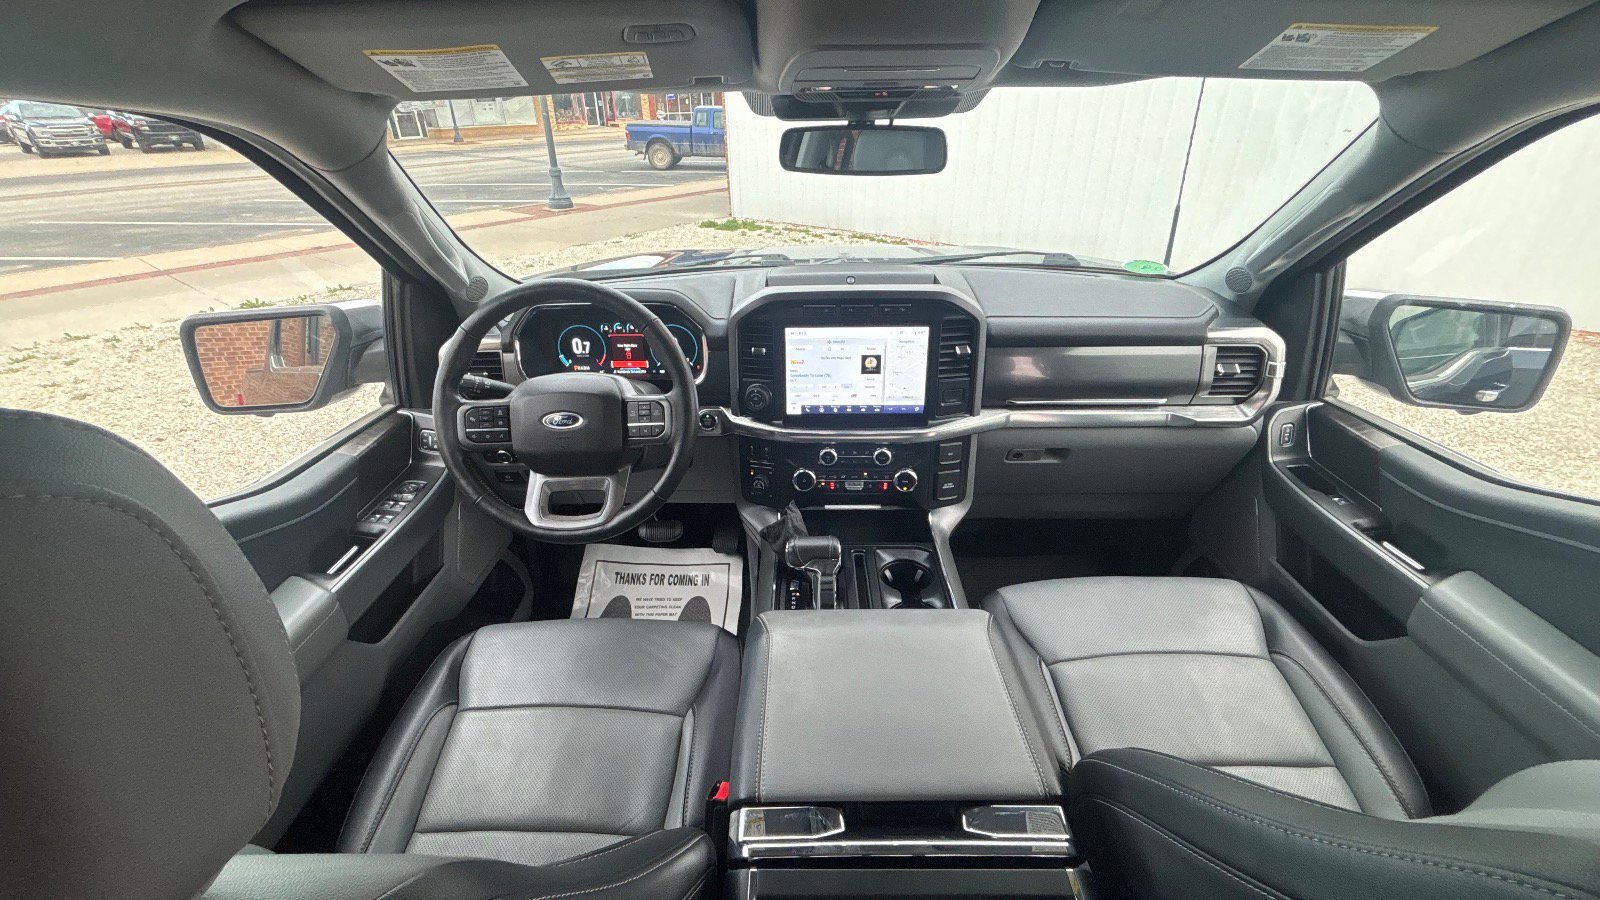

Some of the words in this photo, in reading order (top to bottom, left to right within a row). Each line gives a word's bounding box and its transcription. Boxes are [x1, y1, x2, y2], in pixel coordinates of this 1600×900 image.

[572, 338, 590, 354] 0.7
[552, 416, 573, 425] Ford
[615, 572, 646, 585] THANKS
[649, 574, 665, 585] FOR
[667, 574, 699, 586] COMING
[702, 574, 710, 586] IN
